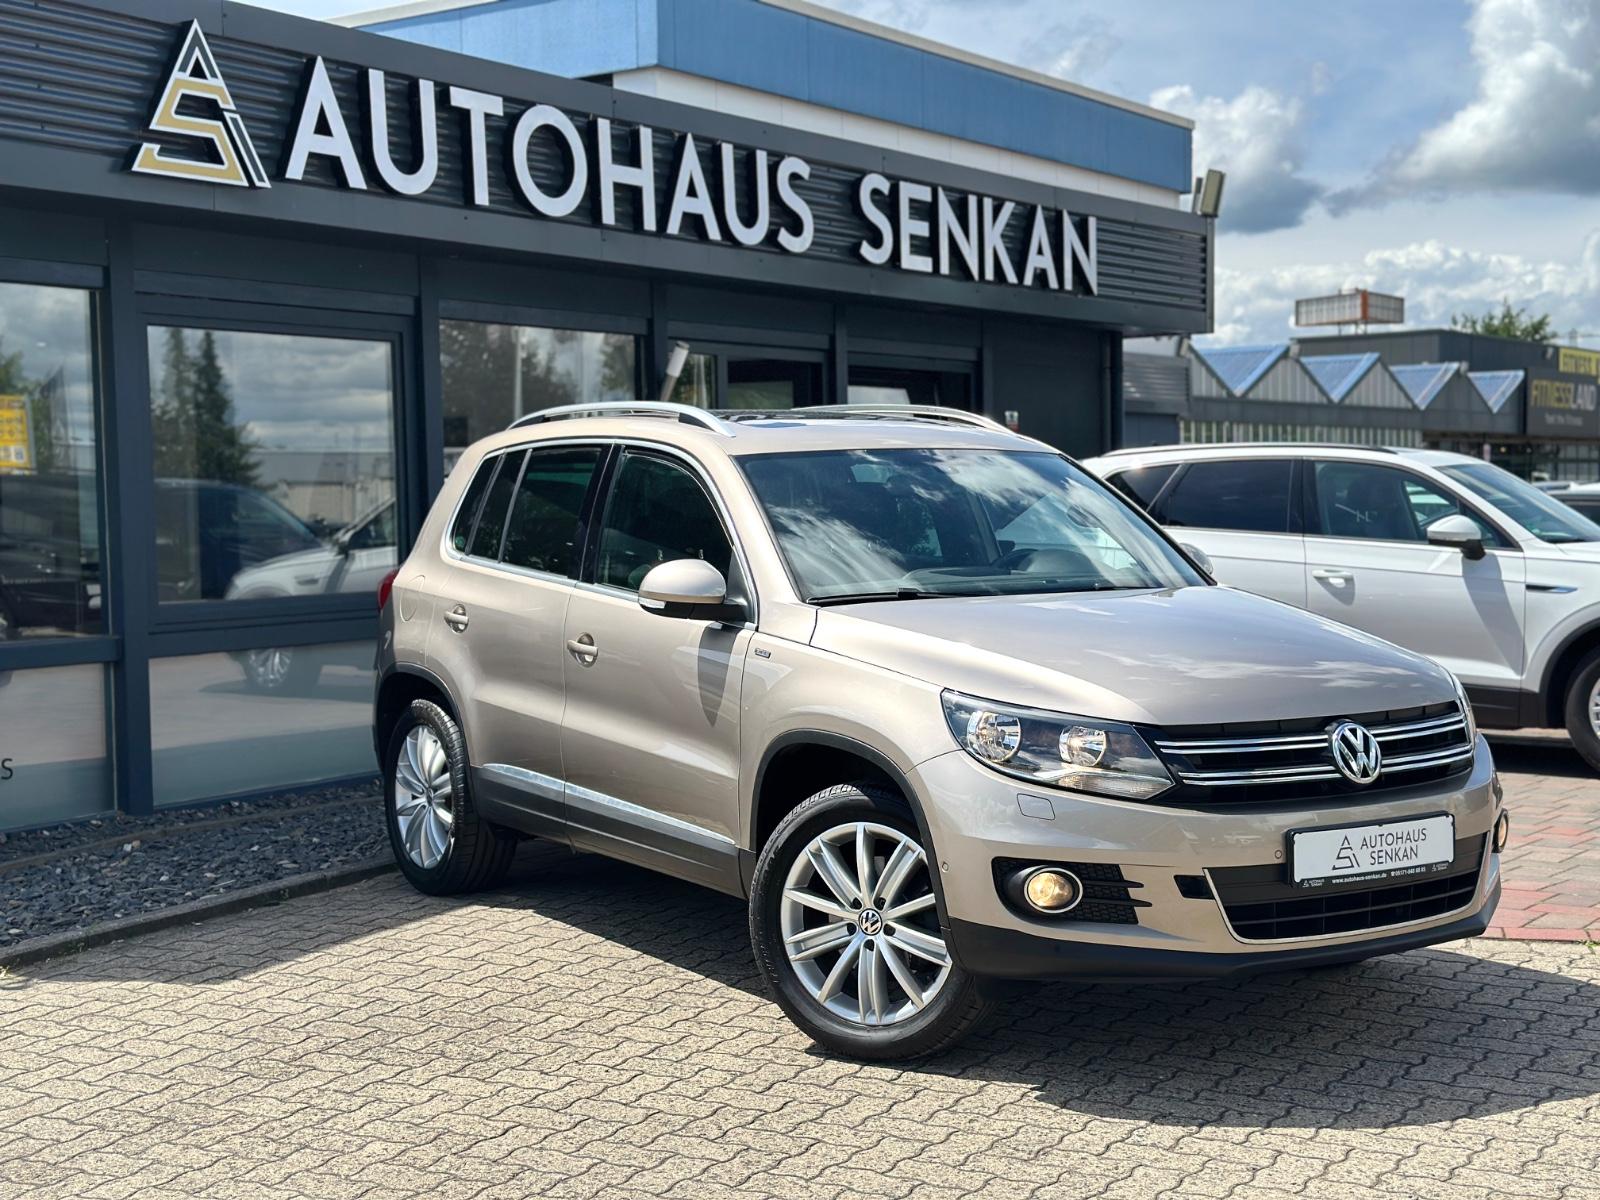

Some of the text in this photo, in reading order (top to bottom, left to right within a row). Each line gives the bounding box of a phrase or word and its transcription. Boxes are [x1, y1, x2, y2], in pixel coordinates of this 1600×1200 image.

[285, 55, 1098, 297] AUTOHAUS SENKAN
[1360, 828, 1427, 851] AUTOHAUS
[1369, 845, 1419, 866] SENKAN
